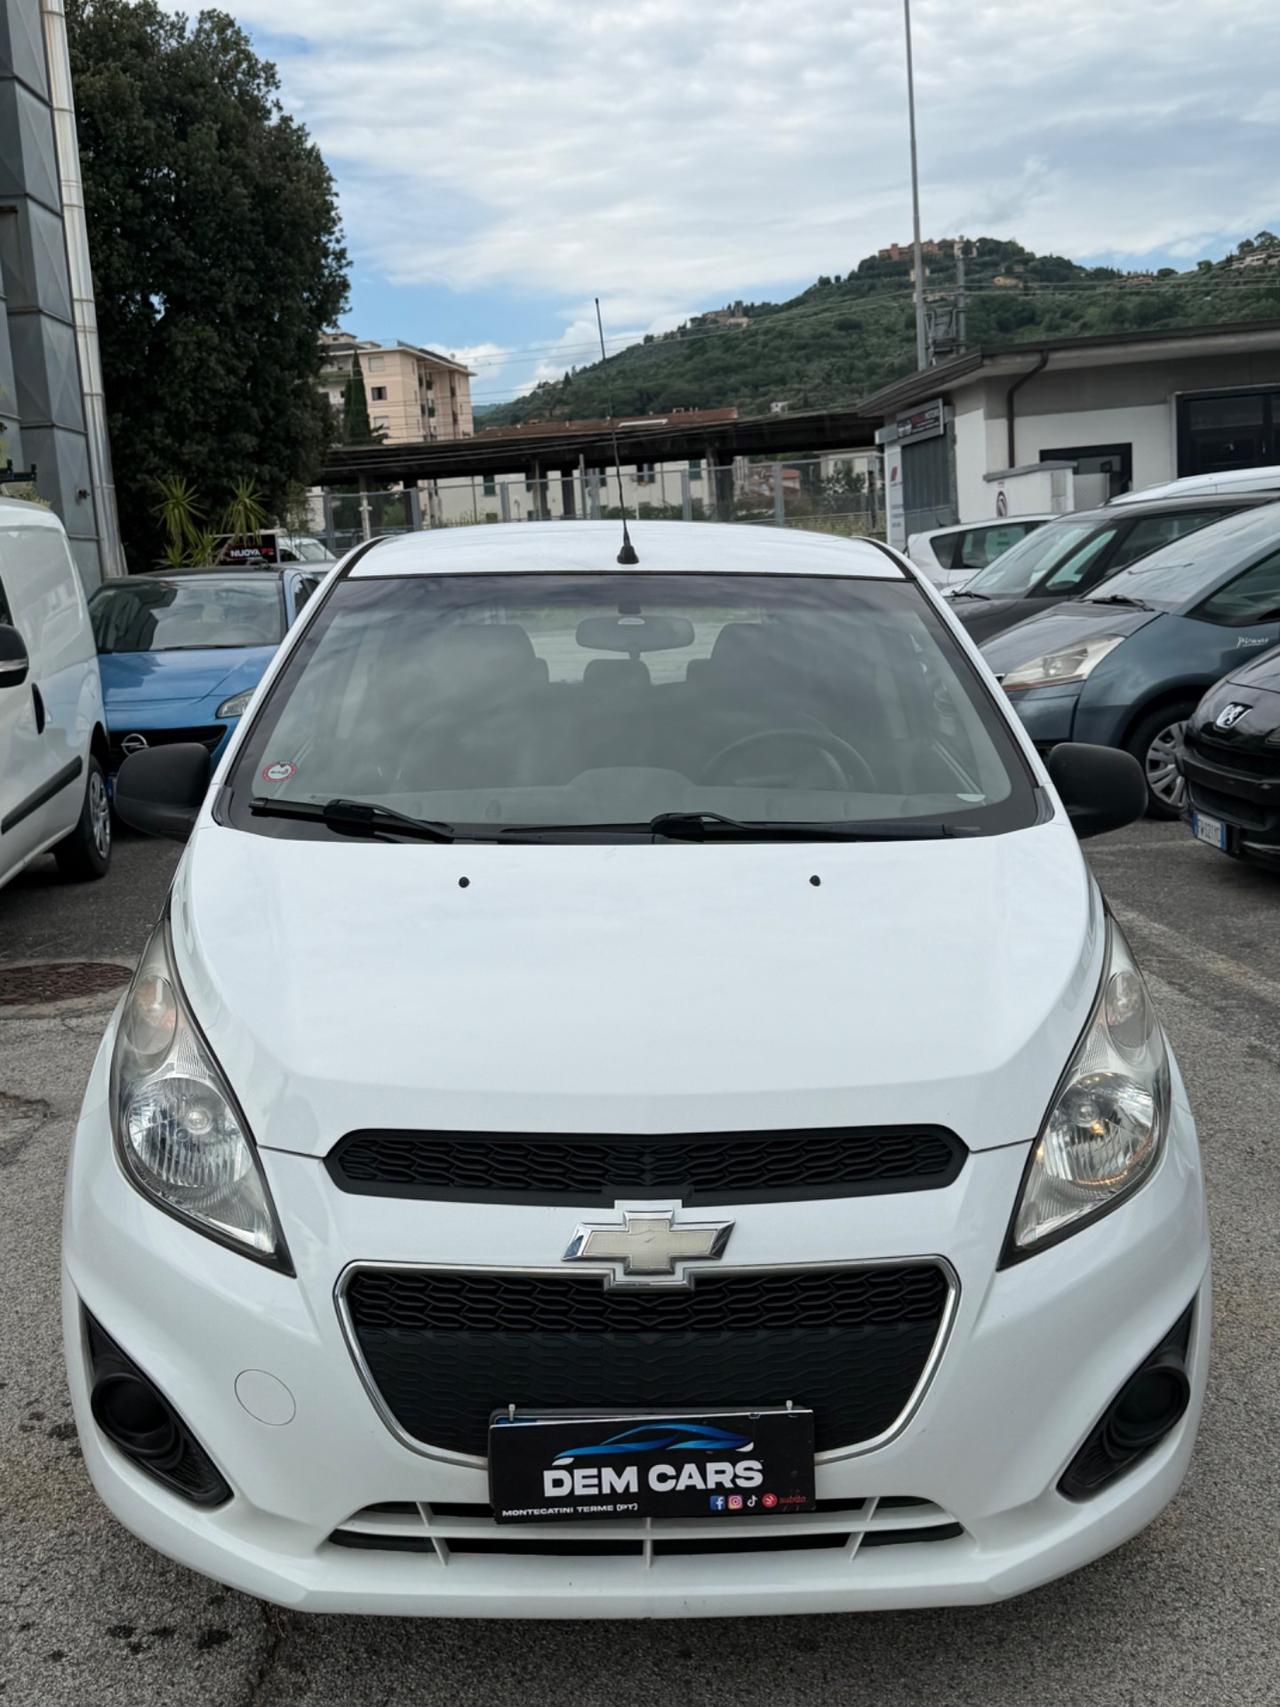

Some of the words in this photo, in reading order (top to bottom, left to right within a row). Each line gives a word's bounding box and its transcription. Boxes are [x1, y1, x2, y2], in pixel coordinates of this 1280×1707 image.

[543, 1466, 639, 1497] DEM
[648, 1459, 764, 1492] CARS
[502, 1507, 574, 1517] MONTECATINI
[576, 1504, 614, 1513] TERME
[616, 1502, 639, 1512] (PT)
